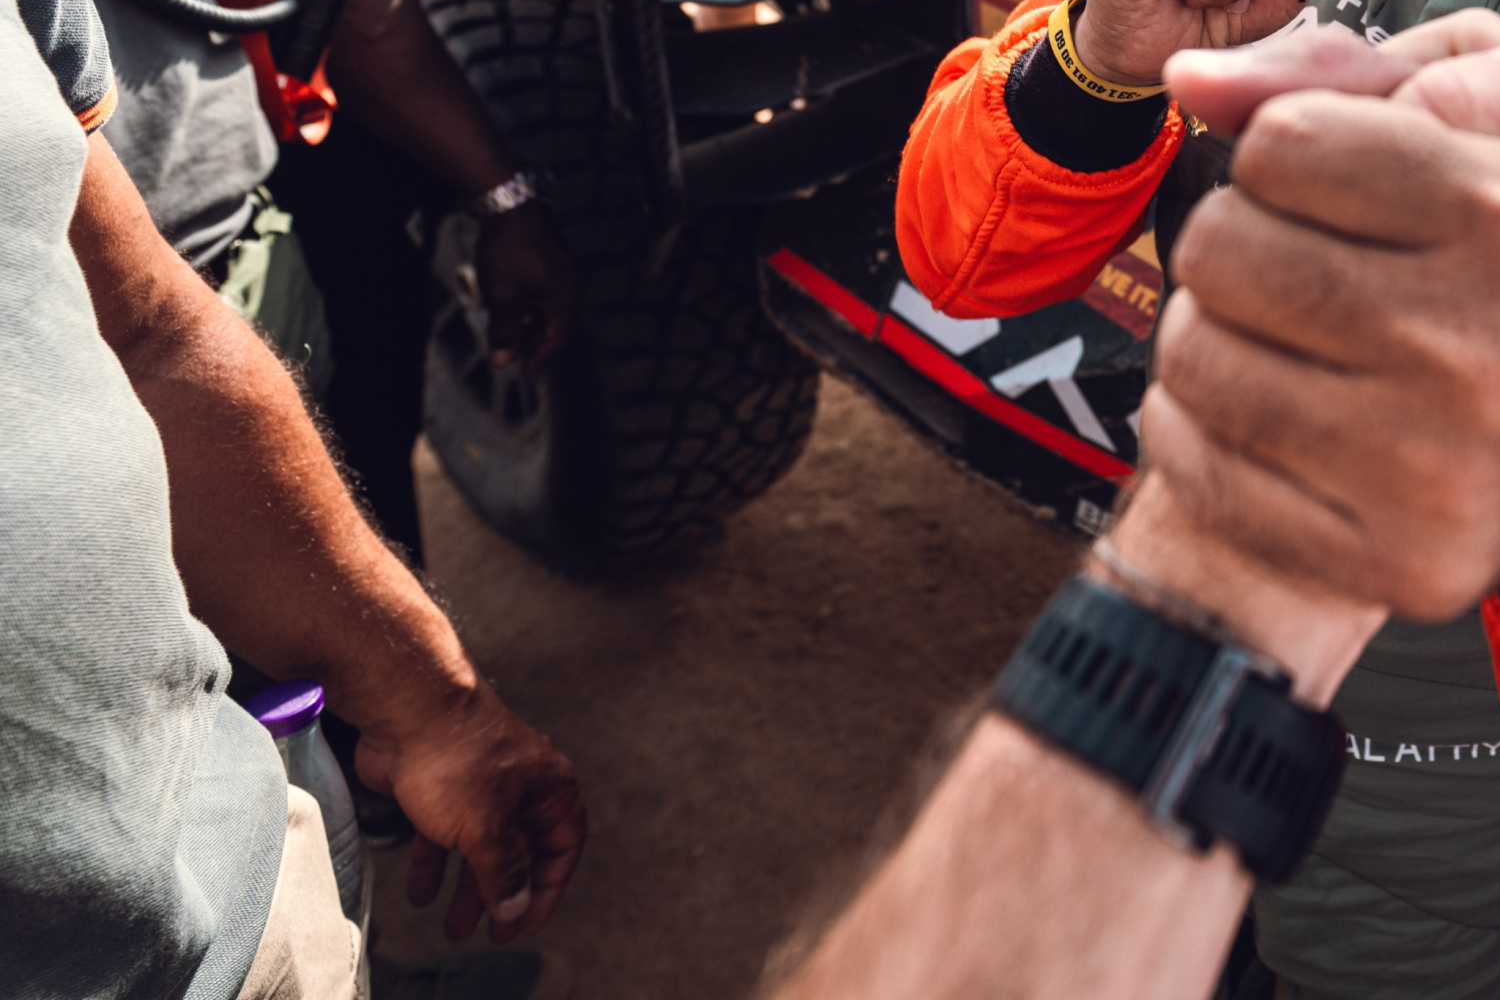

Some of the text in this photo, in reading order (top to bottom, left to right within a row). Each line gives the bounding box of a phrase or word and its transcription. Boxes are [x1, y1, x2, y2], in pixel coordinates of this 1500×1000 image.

[1054, 29, 1066, 51] 60
[1061, 49, 1074, 69] 30
[1073, 65, 1089, 84] 91
[1087, 80, 1108, 94] 40
[1346, 732, 1386, 762] AL
